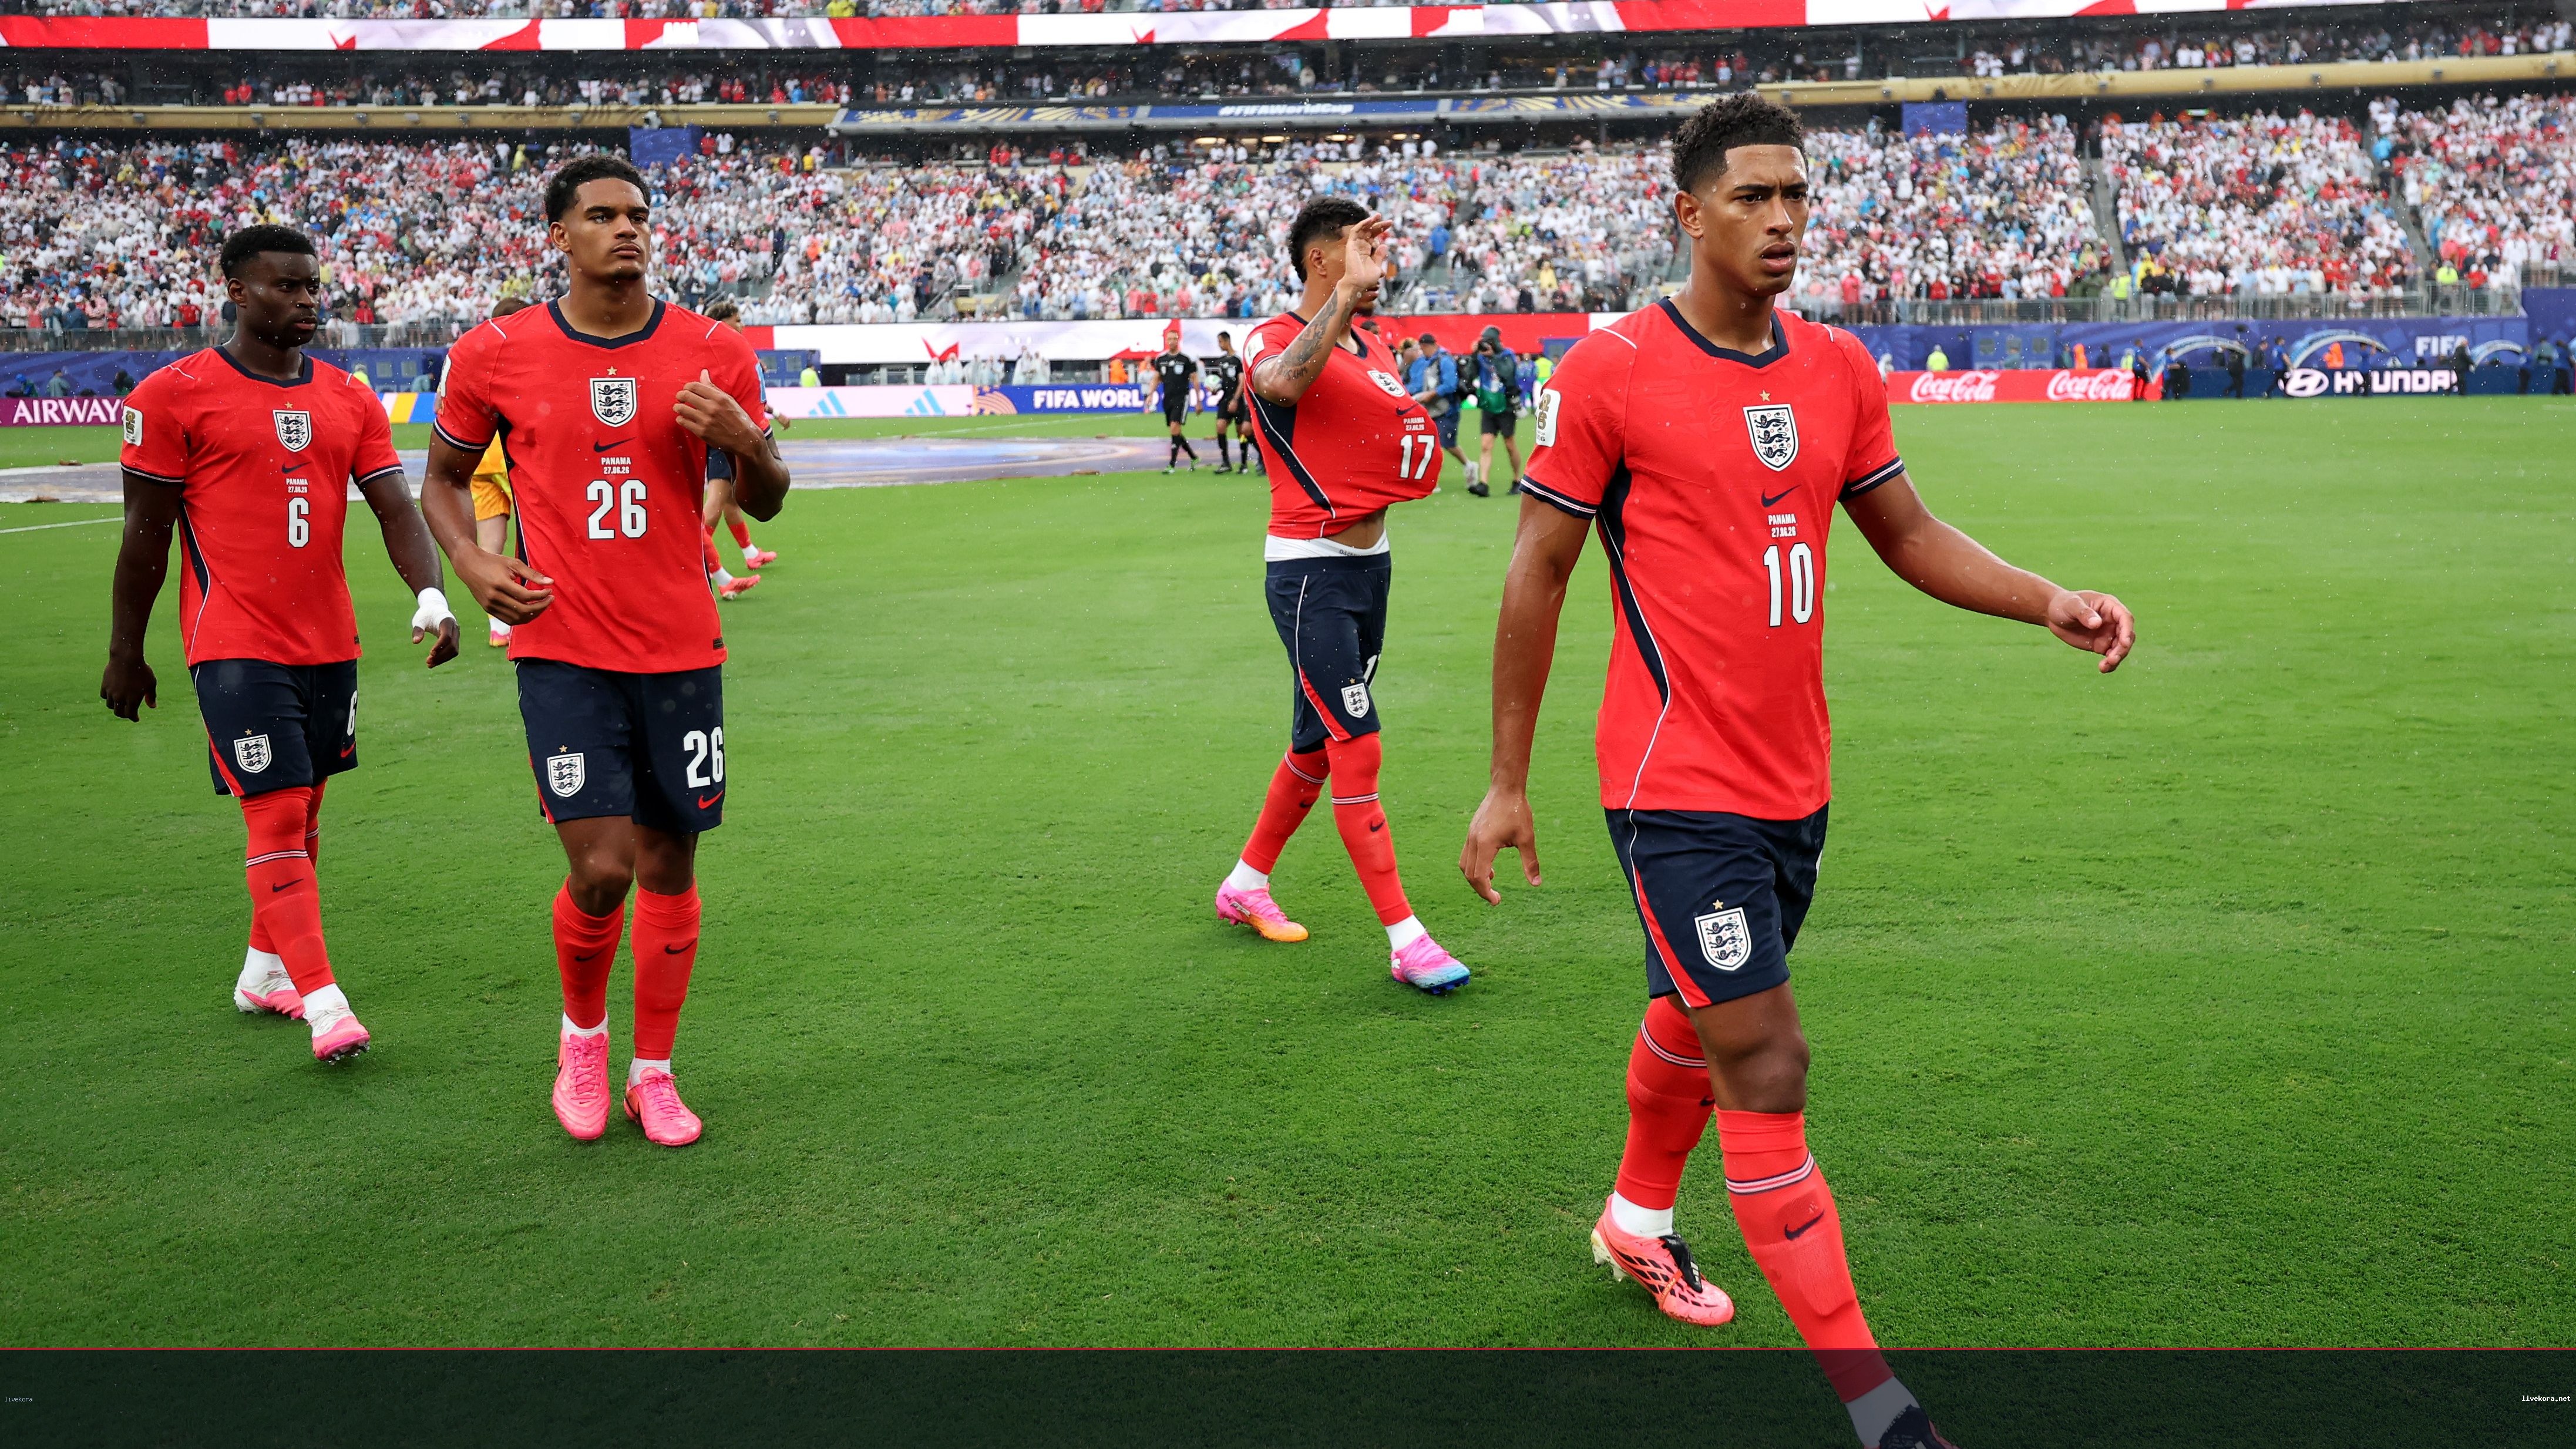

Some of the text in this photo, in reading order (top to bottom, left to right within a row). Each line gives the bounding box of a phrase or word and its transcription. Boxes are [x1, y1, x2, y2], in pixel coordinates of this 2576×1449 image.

[1218, 103, 1354, 116] #FIFAWorldCup
[13, 398, 124, 423] AIRWAY
[1033, 390, 1080, 408] FIFA
[1400, 434, 1435, 479] 17
[288, 497, 310, 548] 6
[586, 479, 647, 539] 26
[1768, 513, 1796, 525] PANAMA
[1763, 542, 1814, 627] 10
[683, 726, 724, 788] 26
